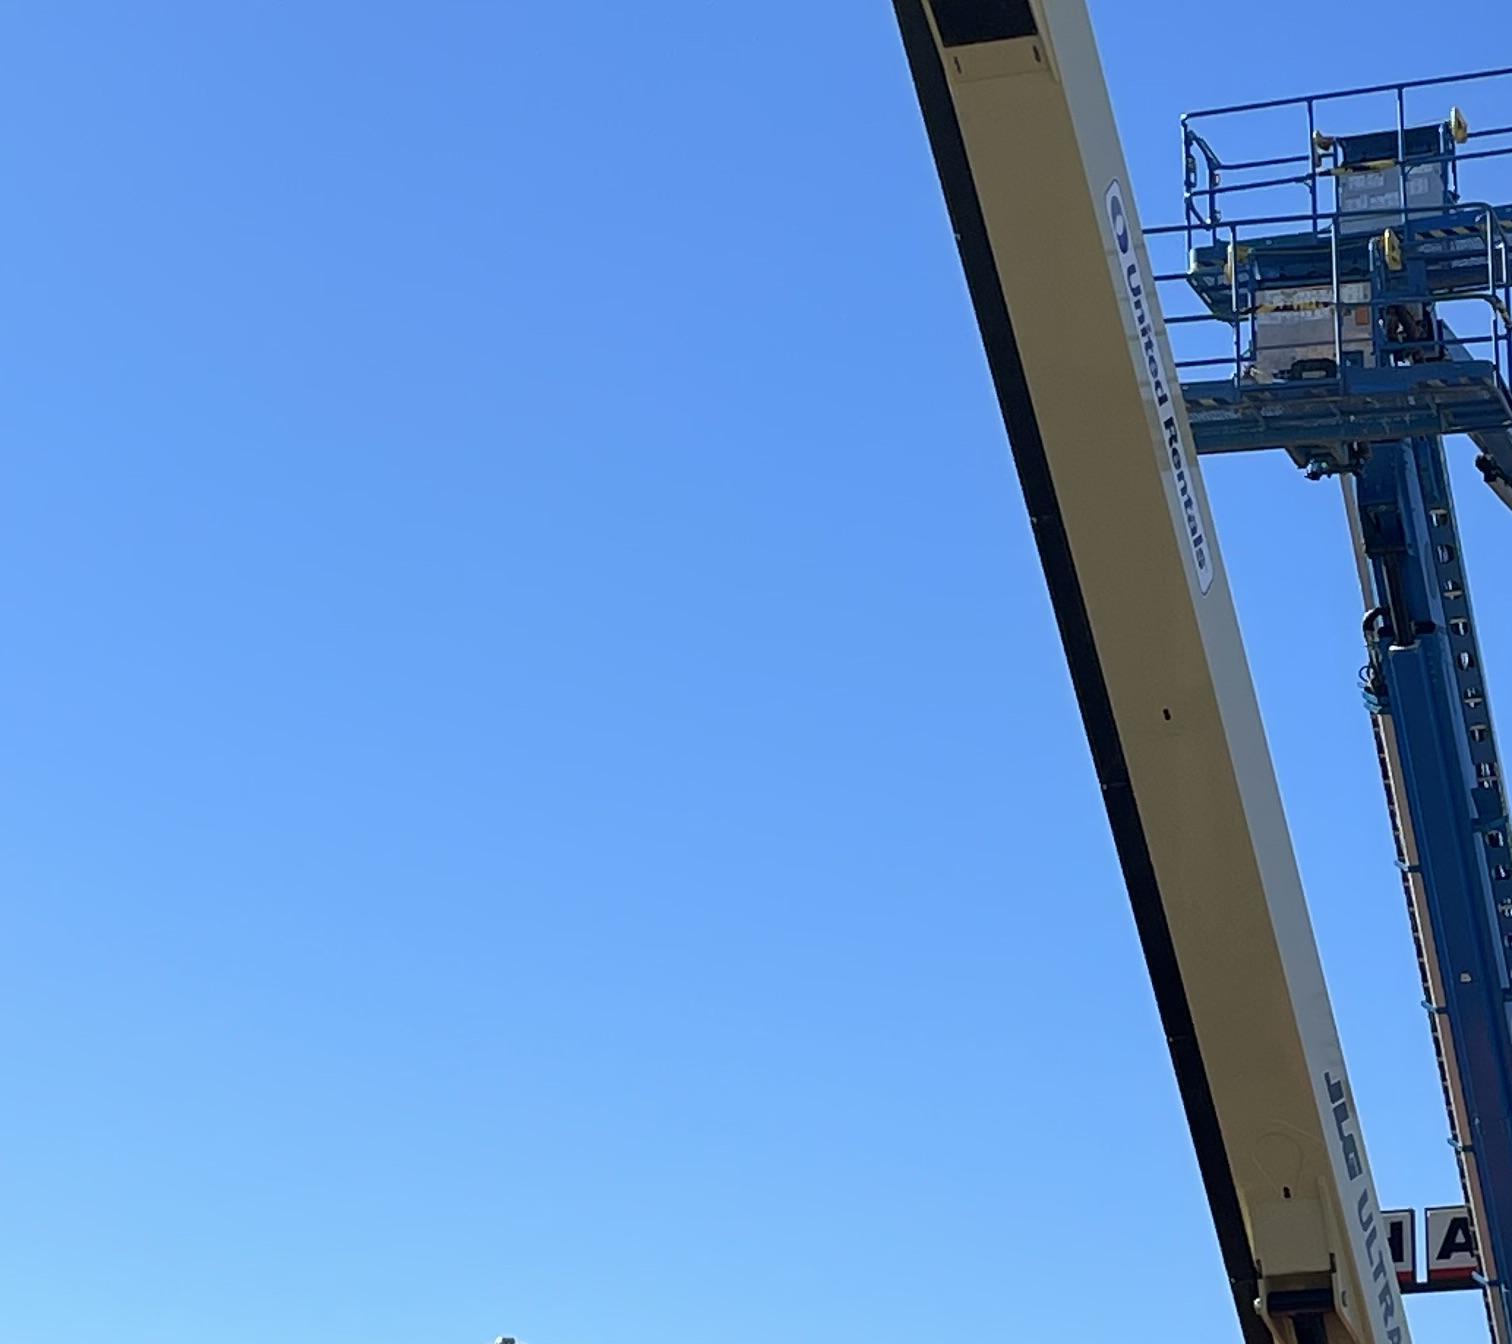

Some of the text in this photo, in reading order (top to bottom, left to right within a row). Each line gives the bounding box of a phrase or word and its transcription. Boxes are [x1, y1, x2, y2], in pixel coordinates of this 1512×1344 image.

[1126, 264, 1206, 570] United Rentals
[1324, 1071, 1363, 1181] JLG
